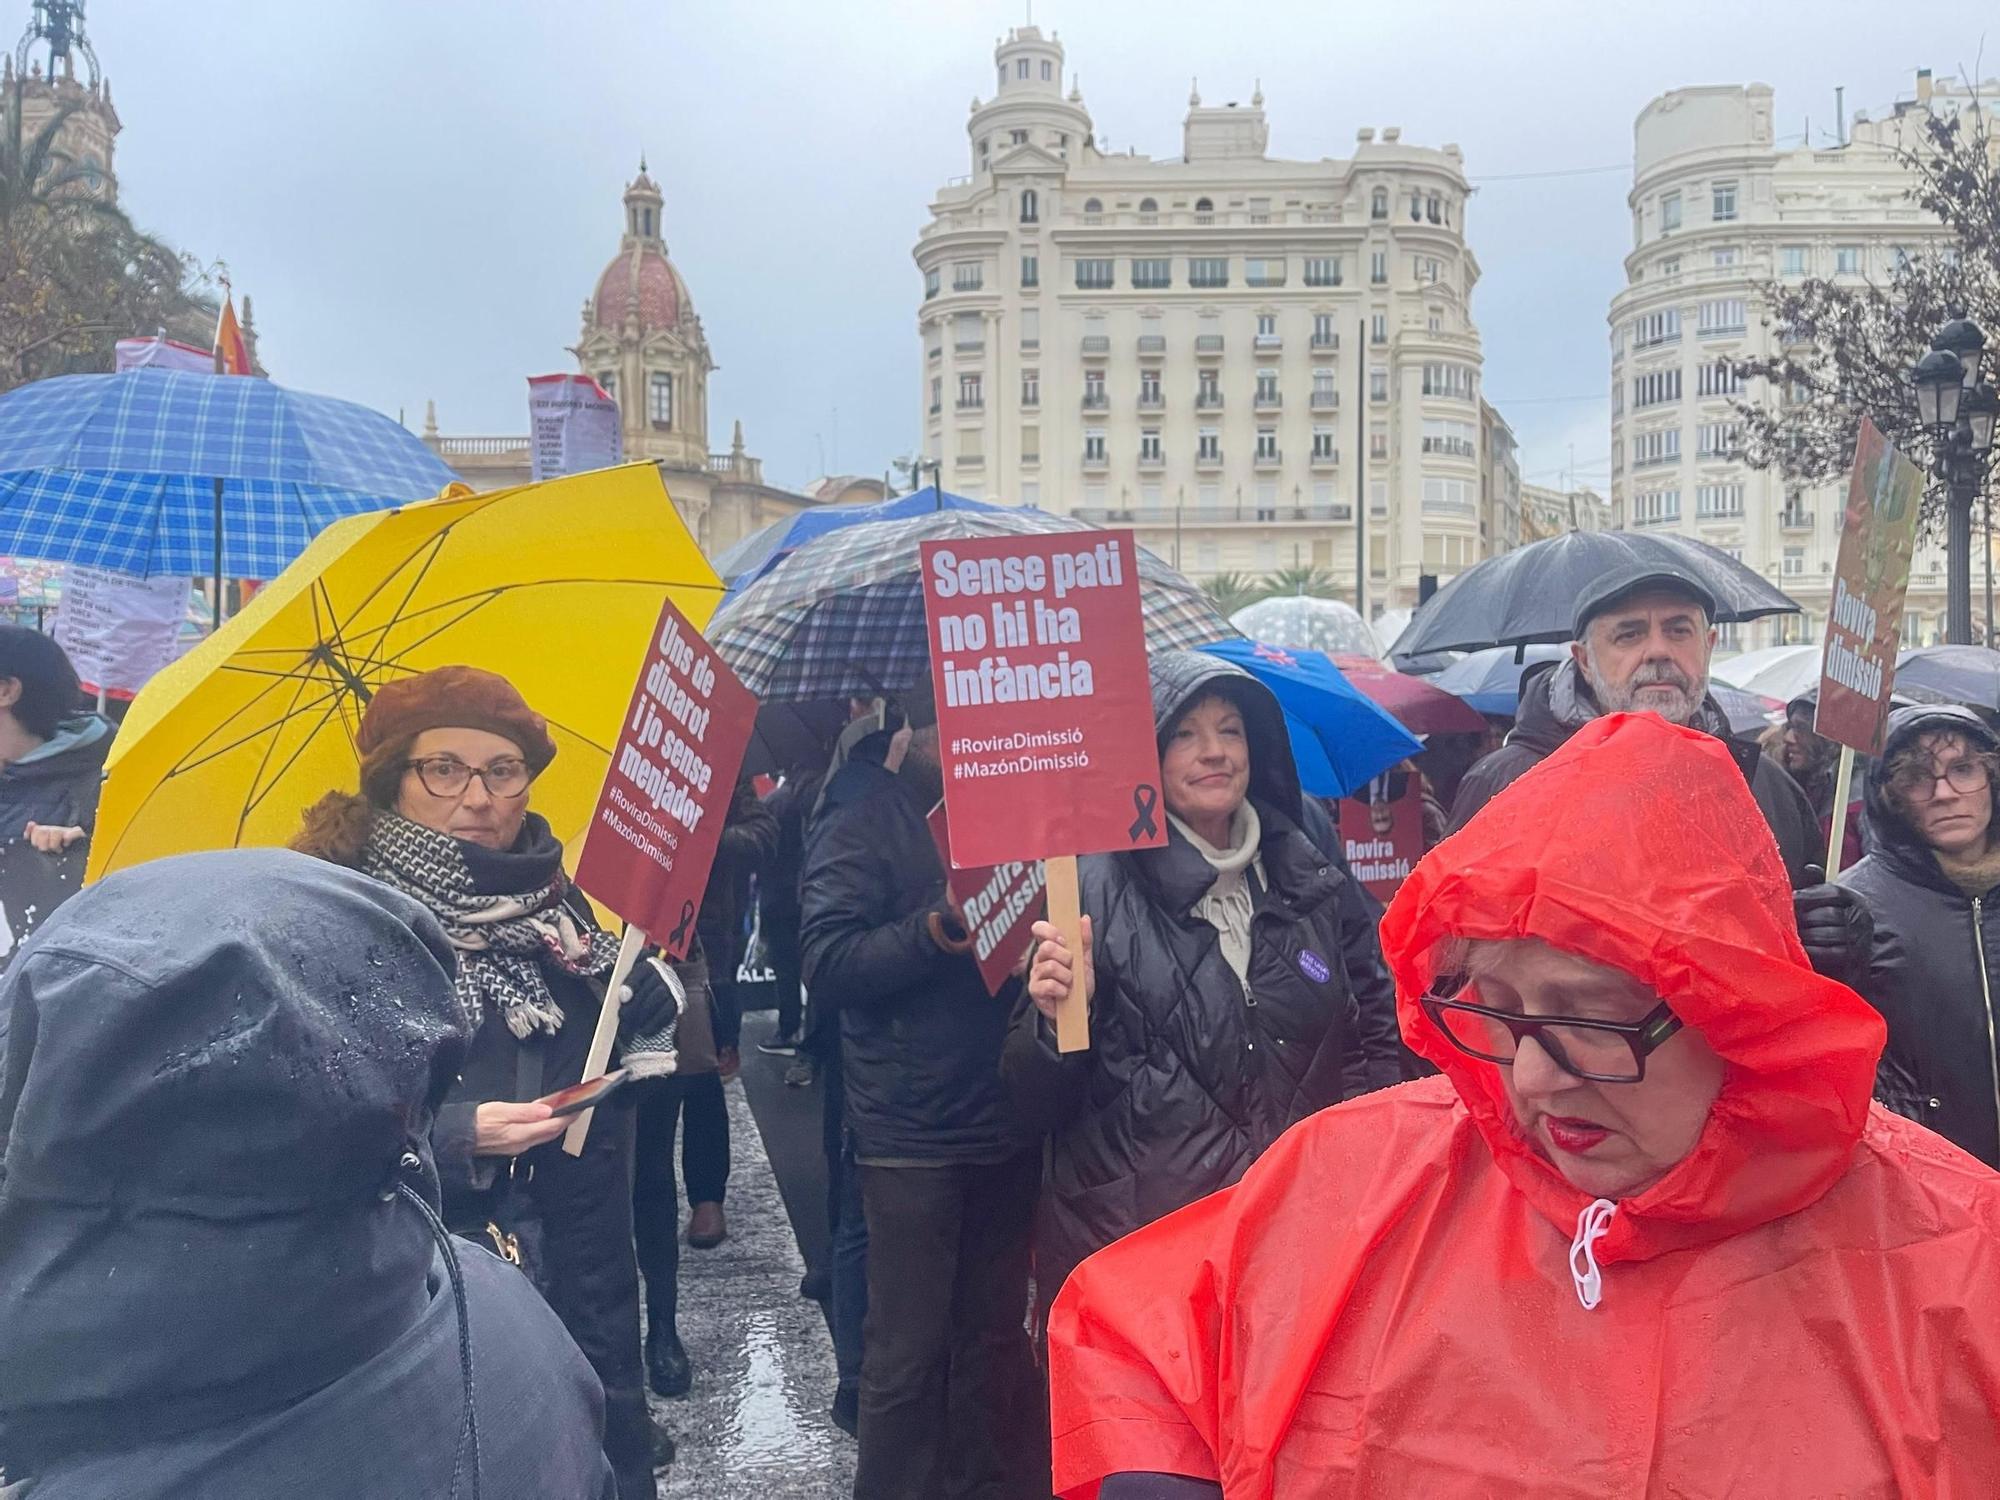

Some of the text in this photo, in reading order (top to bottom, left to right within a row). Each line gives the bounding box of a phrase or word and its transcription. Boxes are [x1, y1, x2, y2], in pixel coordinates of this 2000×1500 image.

[932, 540, 1122, 598] Sense pati
[939, 599, 1081, 652] no hi ha
[1833, 576, 1876, 644] Rovira
[659, 615, 715, 698] Uns de
[943, 651, 1094, 707] infància
[1826, 633, 1882, 701] dimissió
[646, 659, 710, 743] dinarot
[632, 694, 712, 794] i jo sense
[952, 727, 1083, 755] #RoviraDimissió
[954, 750, 1089, 779] #MazónDimissió
[609, 785, 678, 850] #RoviraDimissió
[618, 742, 704, 834] menjador
[601, 807, 673, 872] #MazónDimissió
[1346, 838, 1394, 861] Rovira
